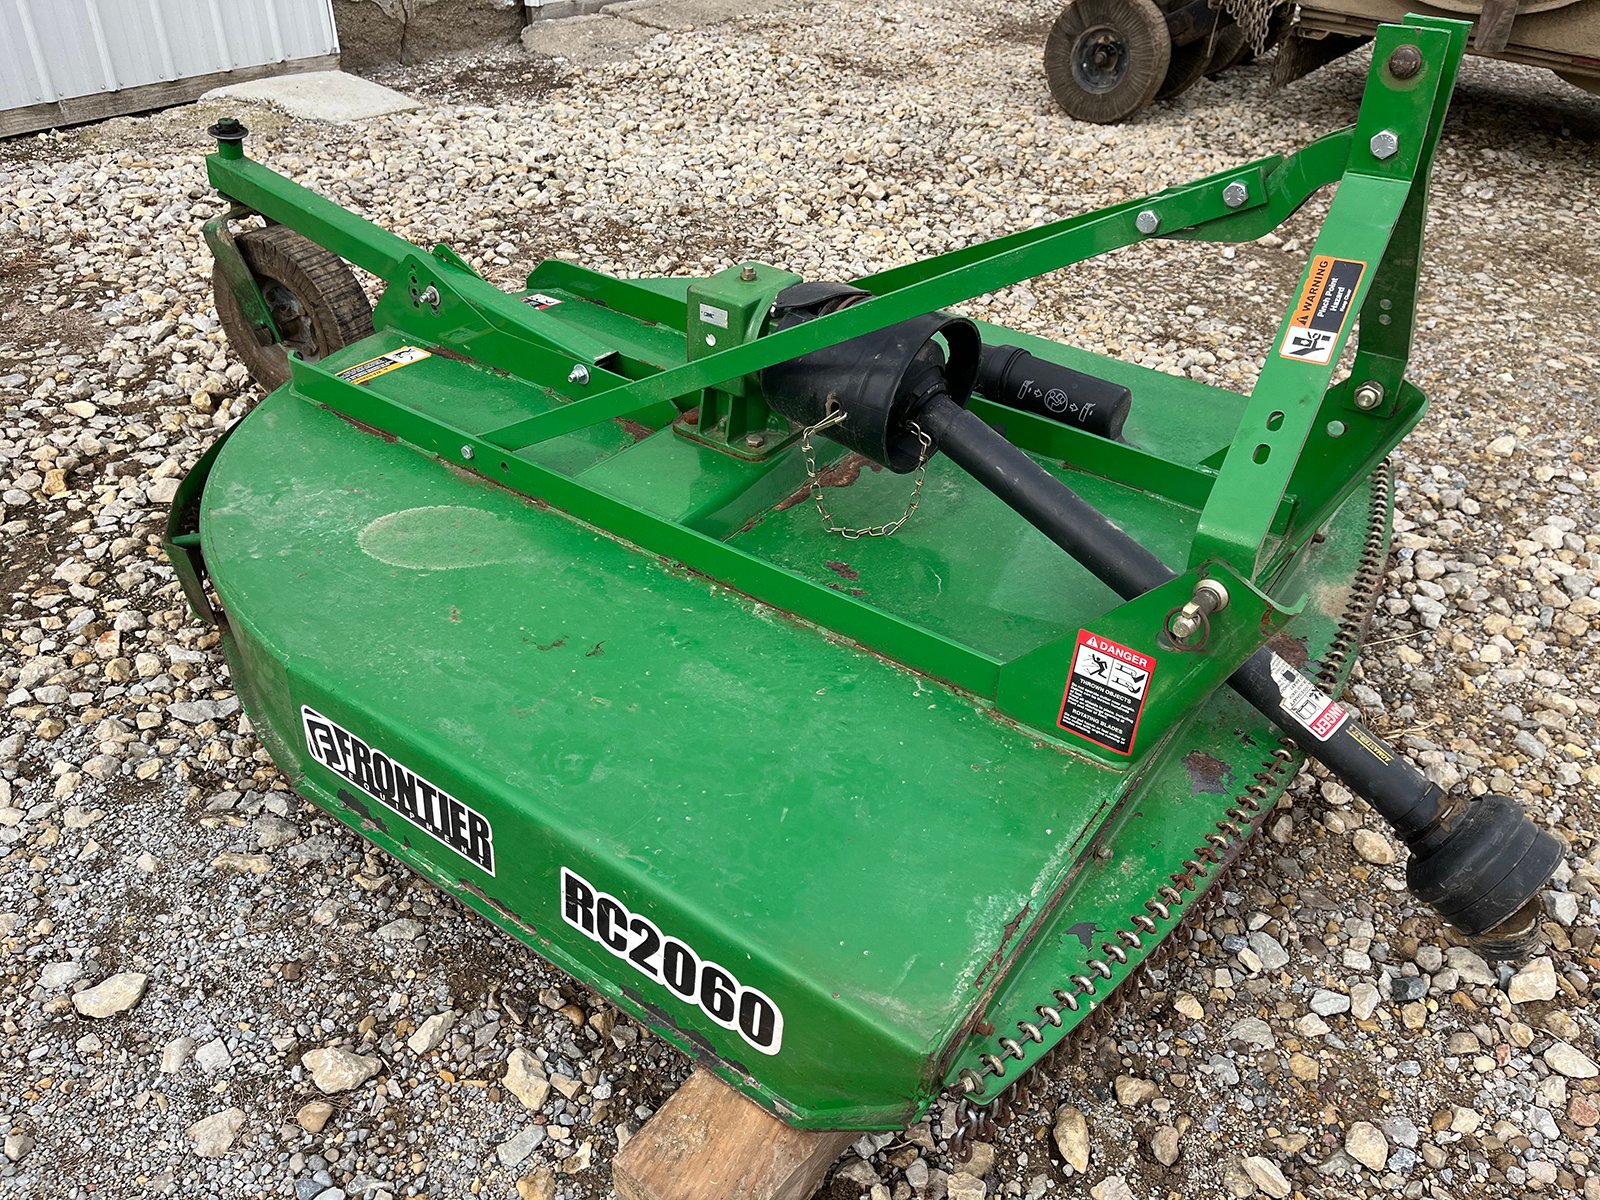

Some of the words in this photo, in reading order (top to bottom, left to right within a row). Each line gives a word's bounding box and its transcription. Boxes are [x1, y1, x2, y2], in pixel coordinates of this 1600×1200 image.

[1302, 260, 1329, 312] WARNING
[1317, 295, 1331, 318] Pinch
[1325, 277, 1339, 297] Point
[1329, 286, 1346, 312] Hazard
[1099, 641, 1148, 668] DANGER
[1080, 678, 1105, 693] THROWN
[1105, 689, 1132, 704] OBJECTS
[1072, 708, 1100, 724] ROTATING
[1099, 721, 1123, 734] BLADES
[1312, 701, 1345, 735] ANGER
[330, 723, 494, 873] FRONTIER
[348, 772, 484, 865] EQUIPMENT
[565, 872, 775, 1047] RC2060
